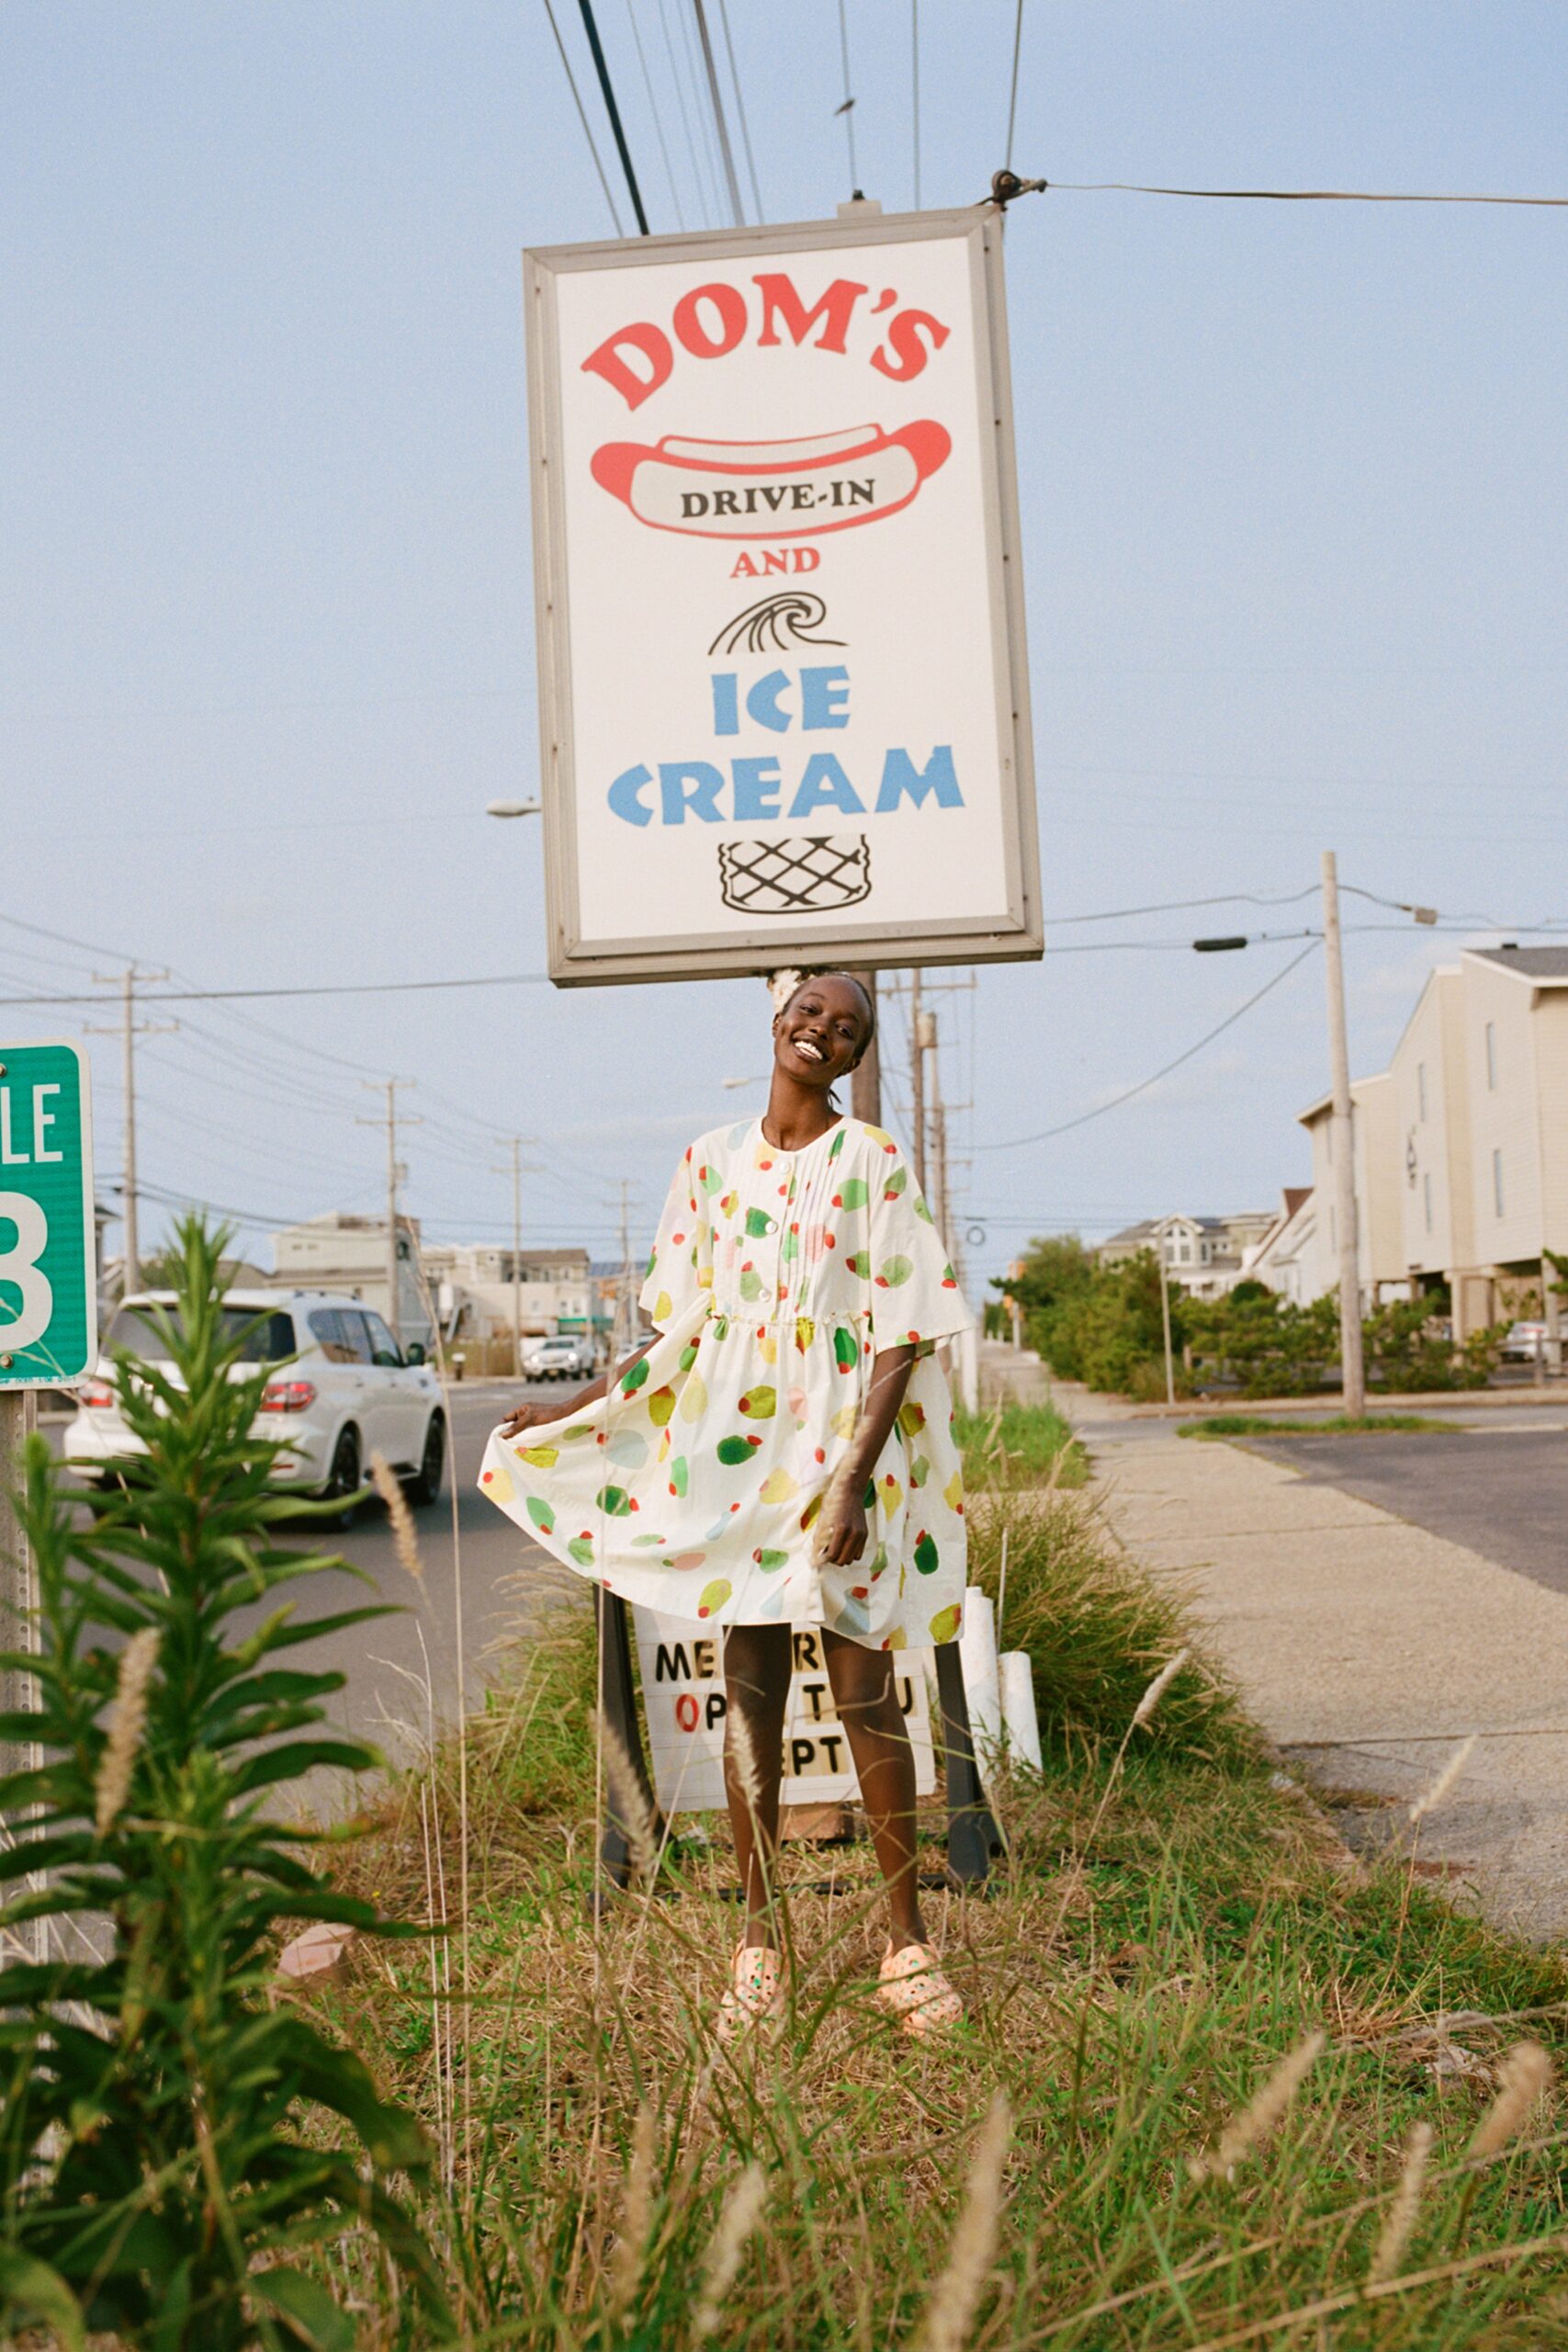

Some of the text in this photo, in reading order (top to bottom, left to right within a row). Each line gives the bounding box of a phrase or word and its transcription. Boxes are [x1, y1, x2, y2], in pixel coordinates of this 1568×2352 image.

[581, 273, 951, 412] DOM'S
[681, 479, 875, 518] DRIVE-IN
[729, 547, 820, 578] AND
[711, 665, 850, 736] ICE
[607, 745, 965, 827] CREAM
[675, 1693, 727, 1733] OP
[782, 1736, 842, 1777] PT
